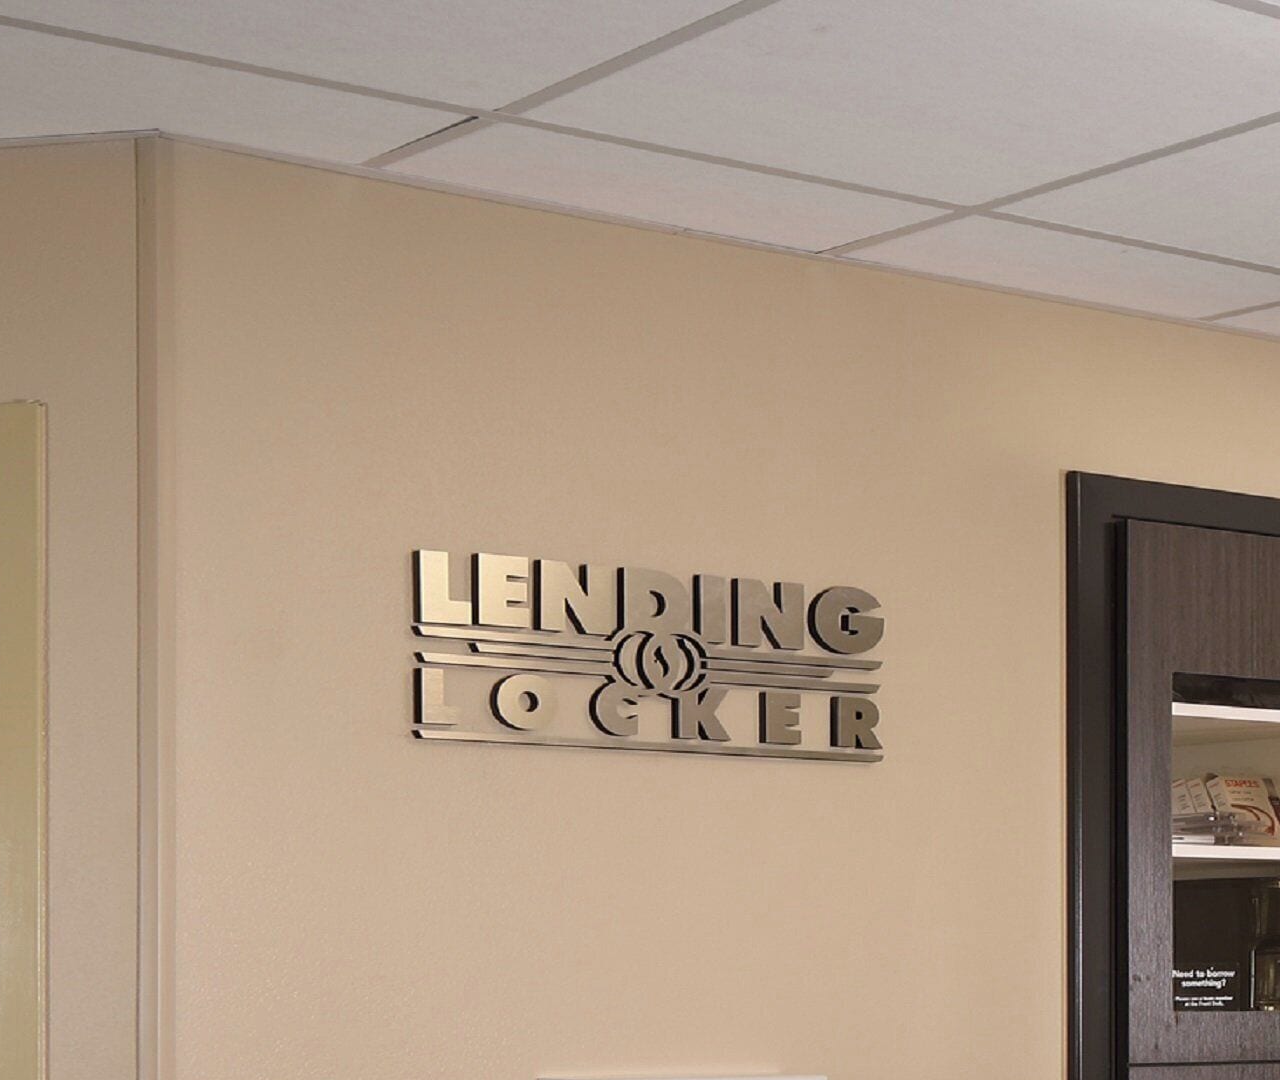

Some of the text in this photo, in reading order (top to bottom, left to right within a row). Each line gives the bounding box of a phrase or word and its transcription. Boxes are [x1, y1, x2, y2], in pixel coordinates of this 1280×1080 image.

[412, 549, 884, 655] LENDING
[413, 667, 882, 751] LOCKER
[1172, 968, 1235, 978] Need to borrow
[1181, 978, 1226, 989] something?
